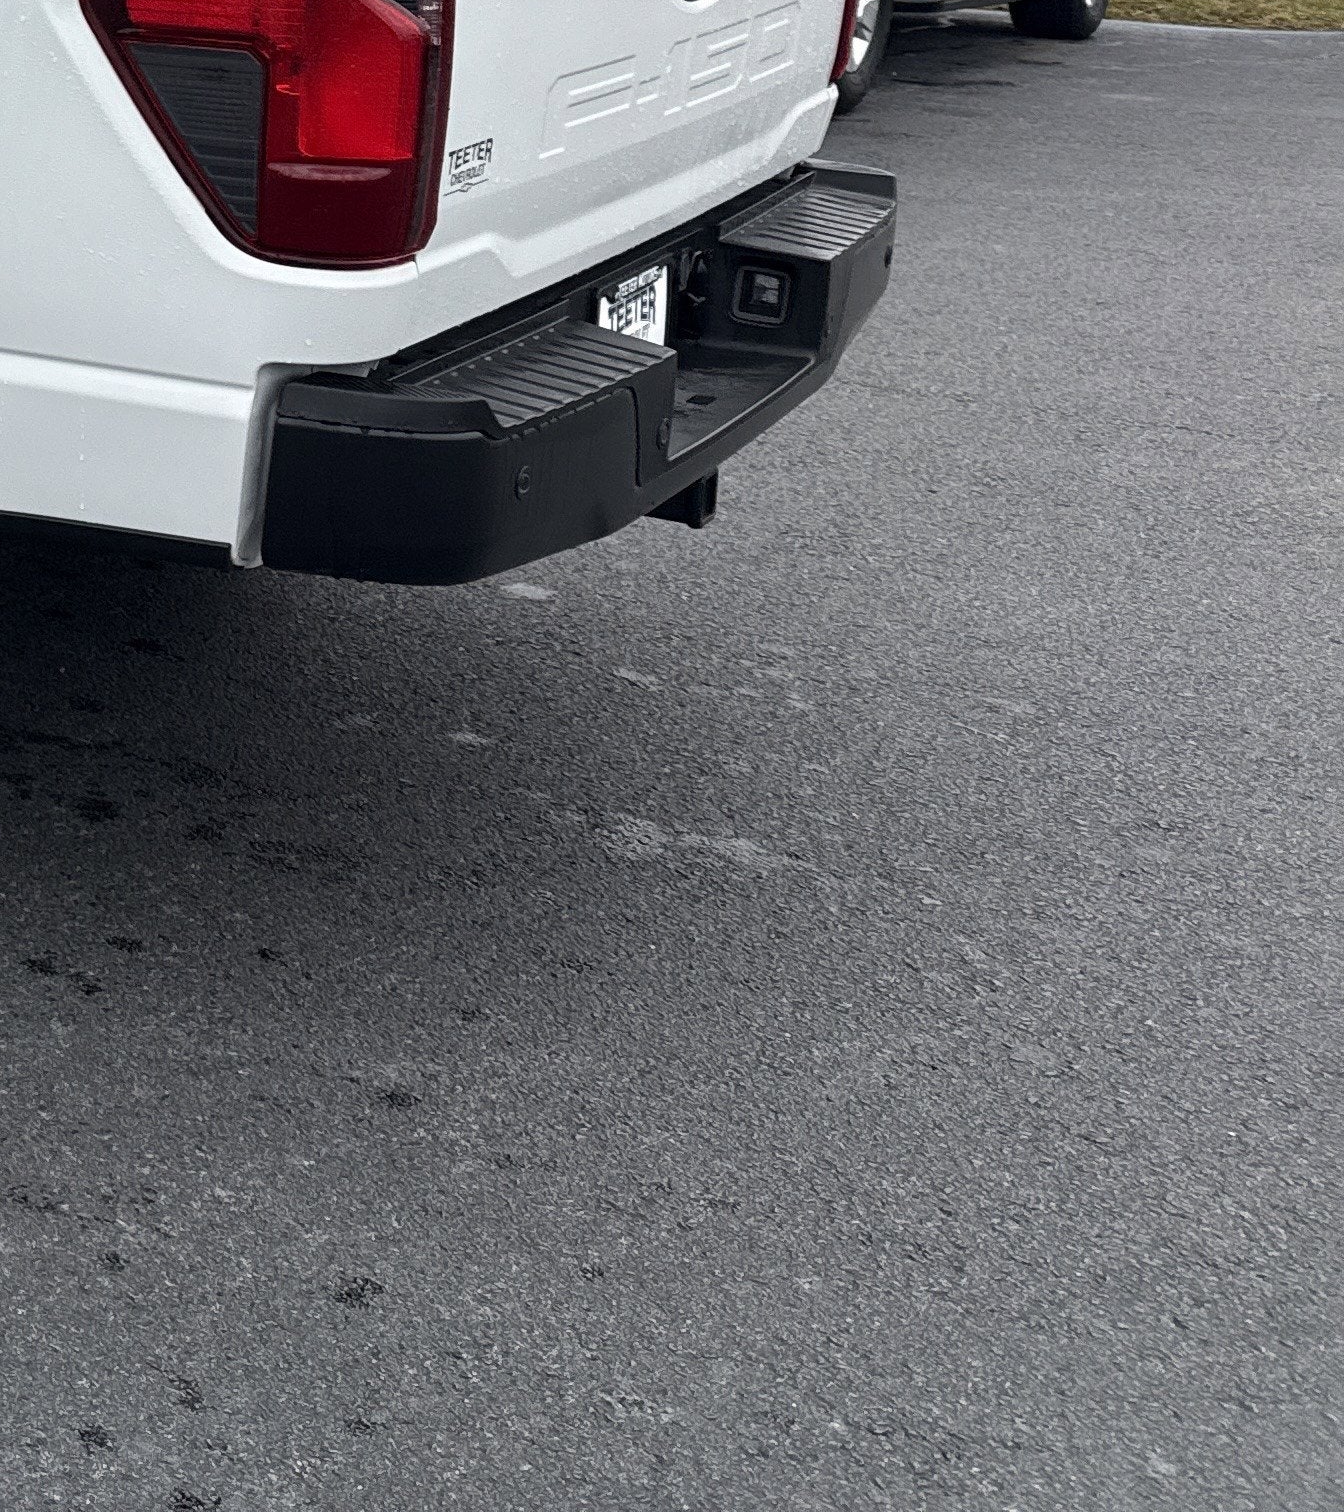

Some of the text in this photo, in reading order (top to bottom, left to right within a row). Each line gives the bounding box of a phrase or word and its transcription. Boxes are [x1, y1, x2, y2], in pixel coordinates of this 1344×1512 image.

[538, 0, 802, 159] F-150
[448, 137, 493, 176] TEETER
[608, 284, 657, 333] TEETER
